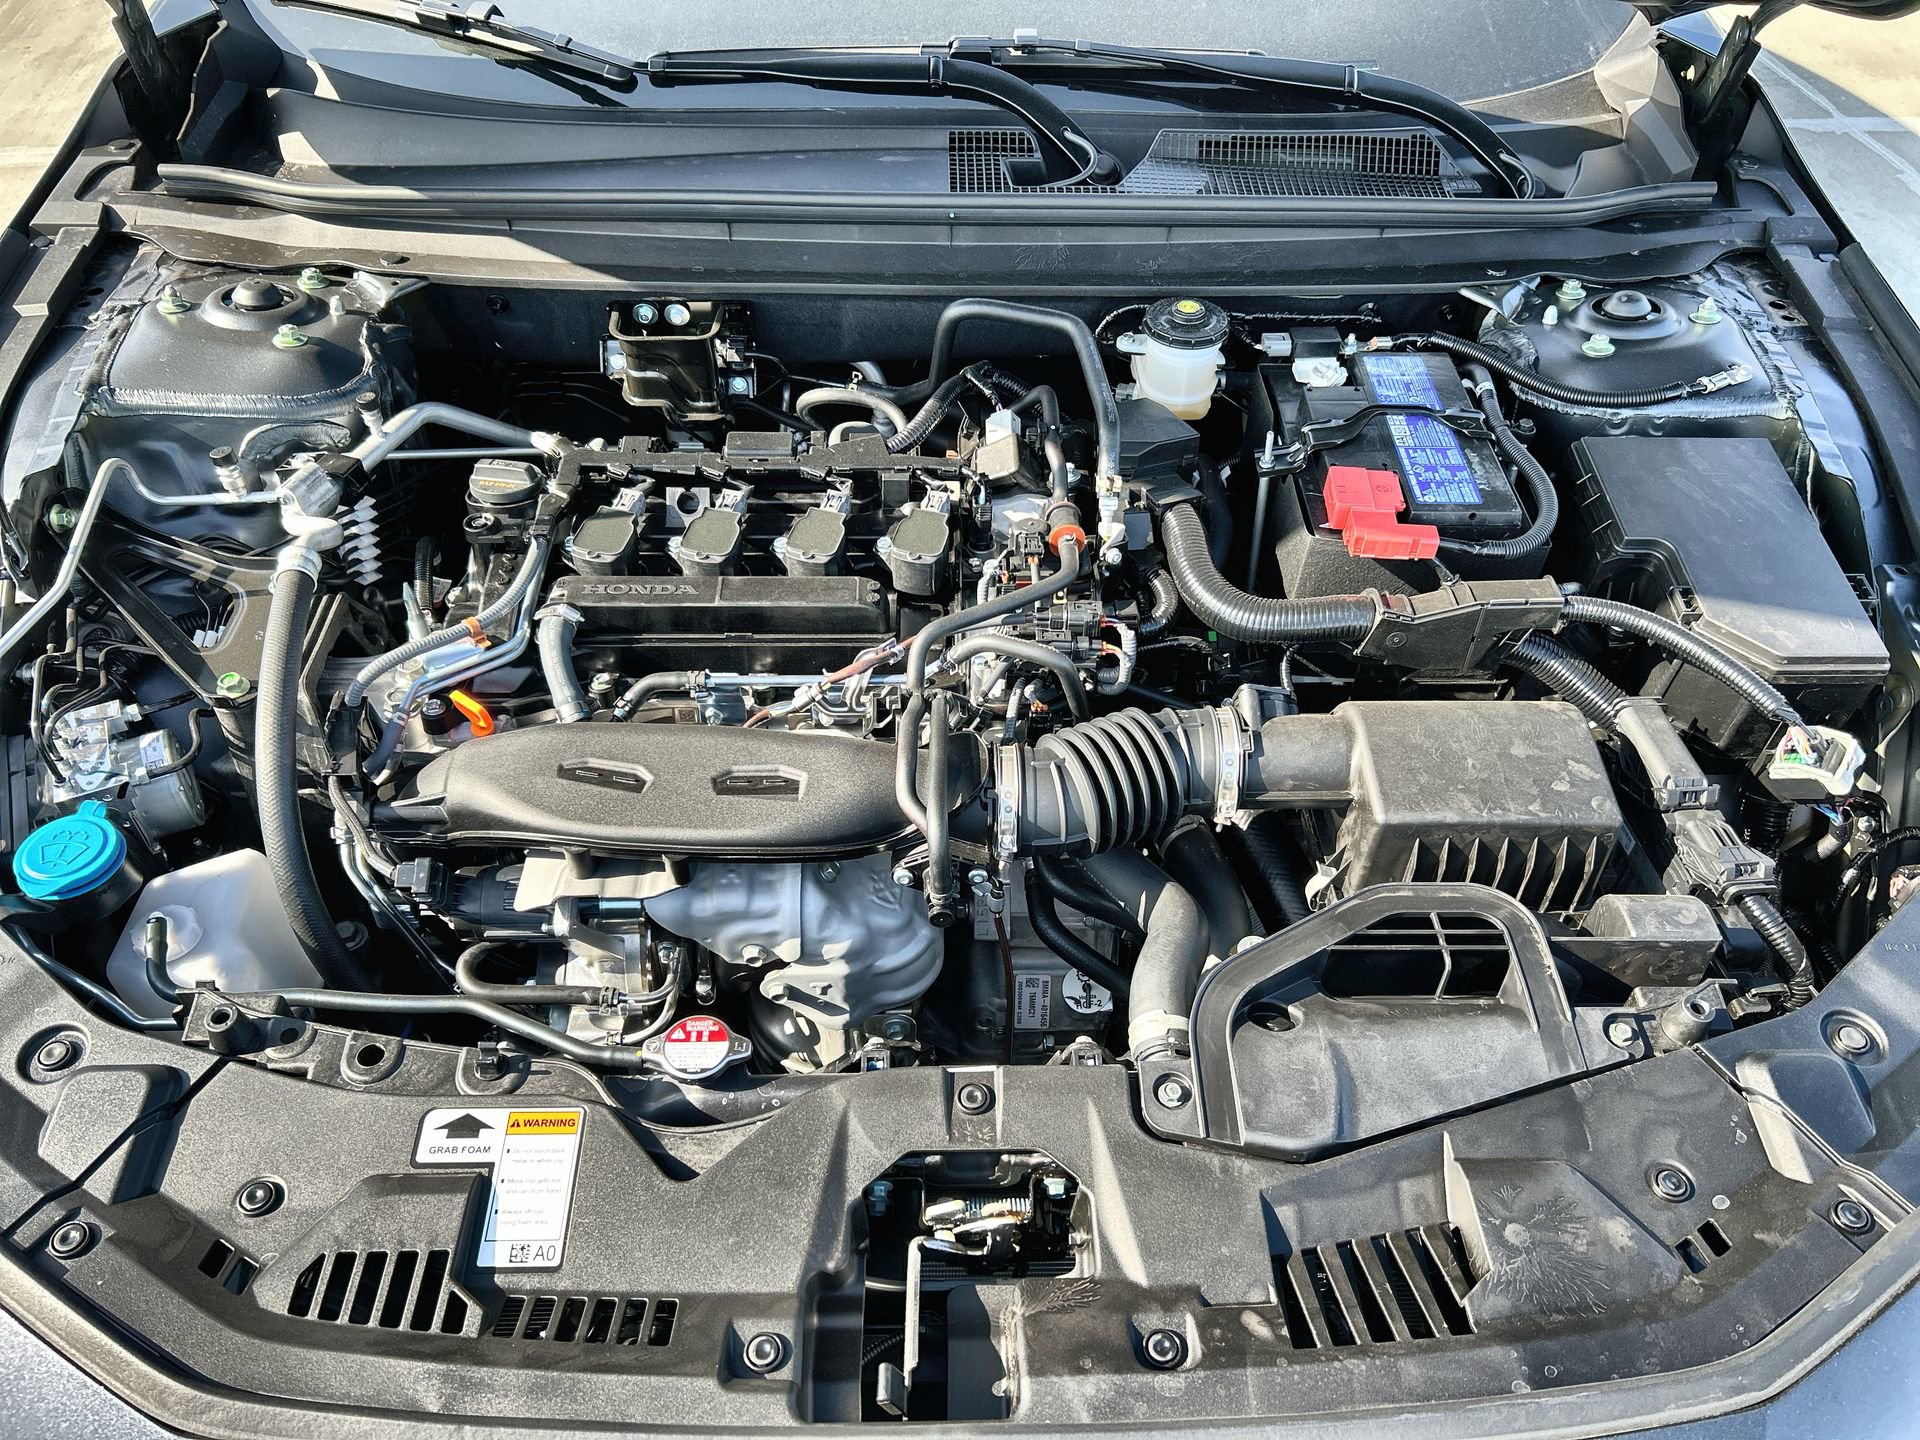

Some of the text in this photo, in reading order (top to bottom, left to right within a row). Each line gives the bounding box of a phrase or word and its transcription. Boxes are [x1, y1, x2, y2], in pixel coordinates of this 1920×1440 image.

[581, 584, 699, 596] HONDA
[523, 1118, 576, 1128] WARNING
[428, 1146, 491, 1154] GRAB FOAM
[533, 1245, 556, 1261] A0
